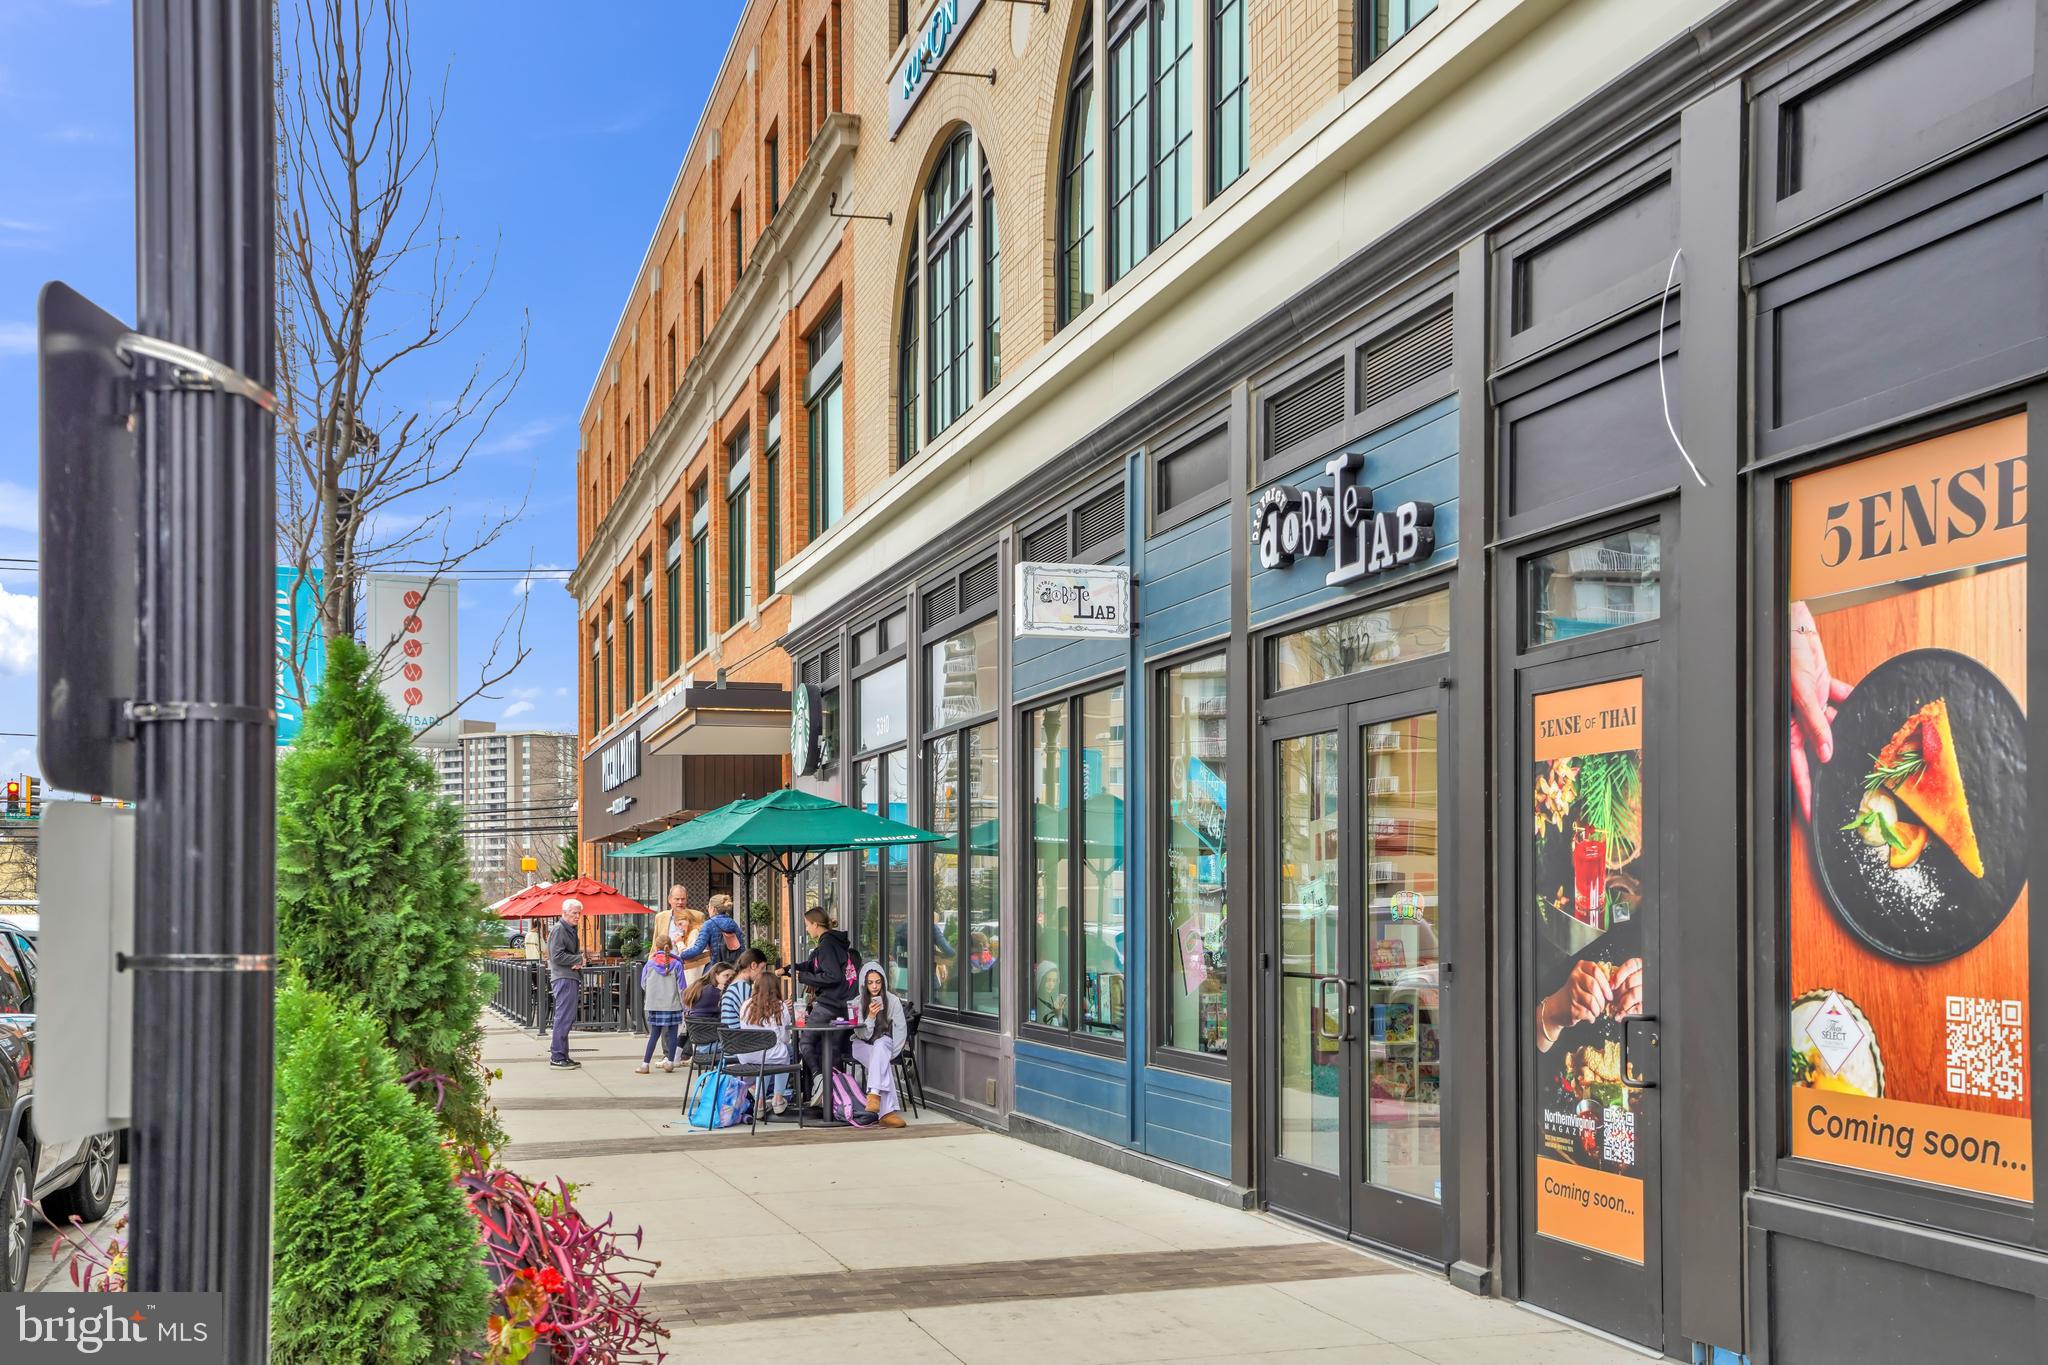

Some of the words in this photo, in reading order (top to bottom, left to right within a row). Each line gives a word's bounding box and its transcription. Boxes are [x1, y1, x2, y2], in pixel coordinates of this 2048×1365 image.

[1584, 717, 1597, 729] OF
[1600, 706, 1637, 730] THAI
[1821, 1031, 1847, 1041] SELECT
[1544, 1122, 1596, 1139] MAGAZINE
[1807, 1104, 1914, 1159] Coming
[1923, 1130, 2027, 1172] soon...
[1544, 1177, 1590, 1208] Coming
[1593, 1192, 1635, 1215] soon...
